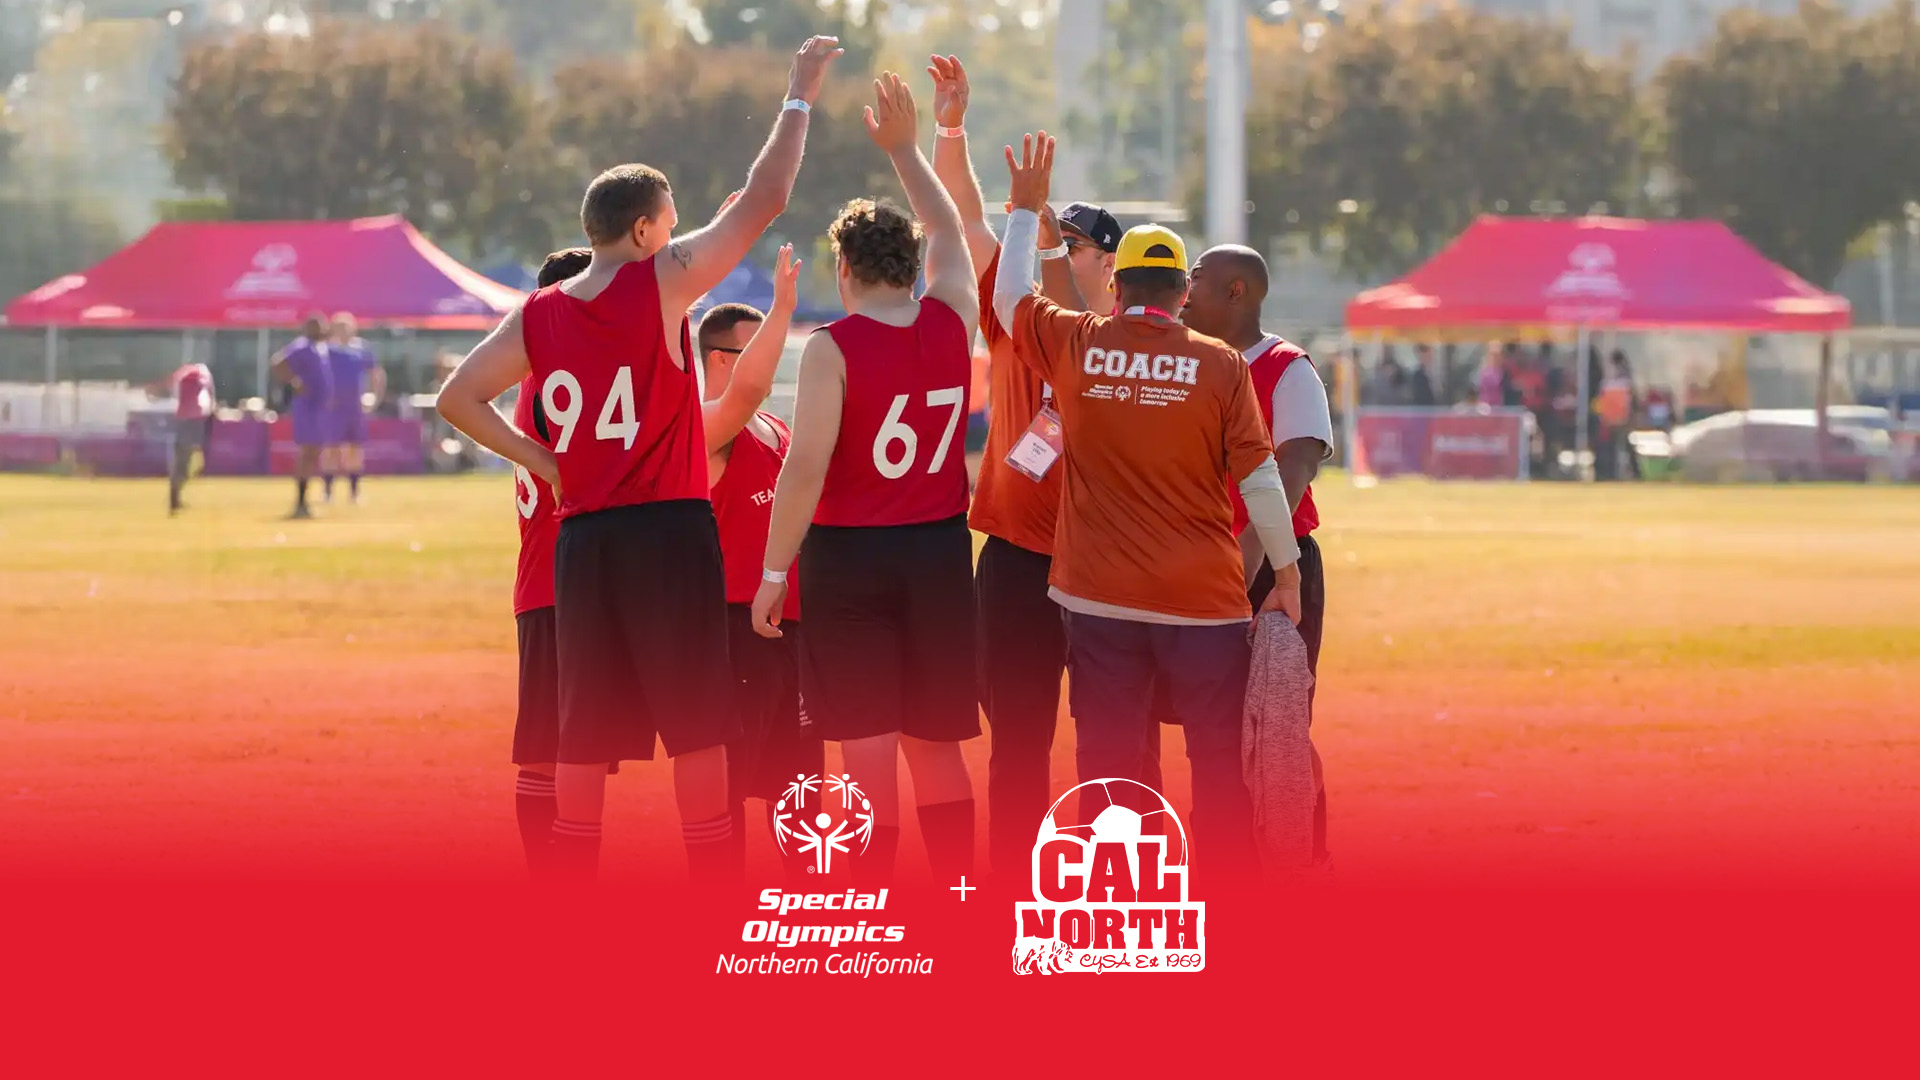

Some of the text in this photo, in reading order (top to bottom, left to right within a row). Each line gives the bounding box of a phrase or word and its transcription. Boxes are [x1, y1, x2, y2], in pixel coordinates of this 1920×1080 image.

[1083, 347, 1200, 385] COACH
[1140, 385, 1162, 393] Playing
[1160, 393, 1186, 402] inclusive
[541, 366, 640, 453] 94
[1139, 399, 1168, 407] tomorrow
[872, 385, 964, 479] 67
[751, 488, 775, 506] TEA
